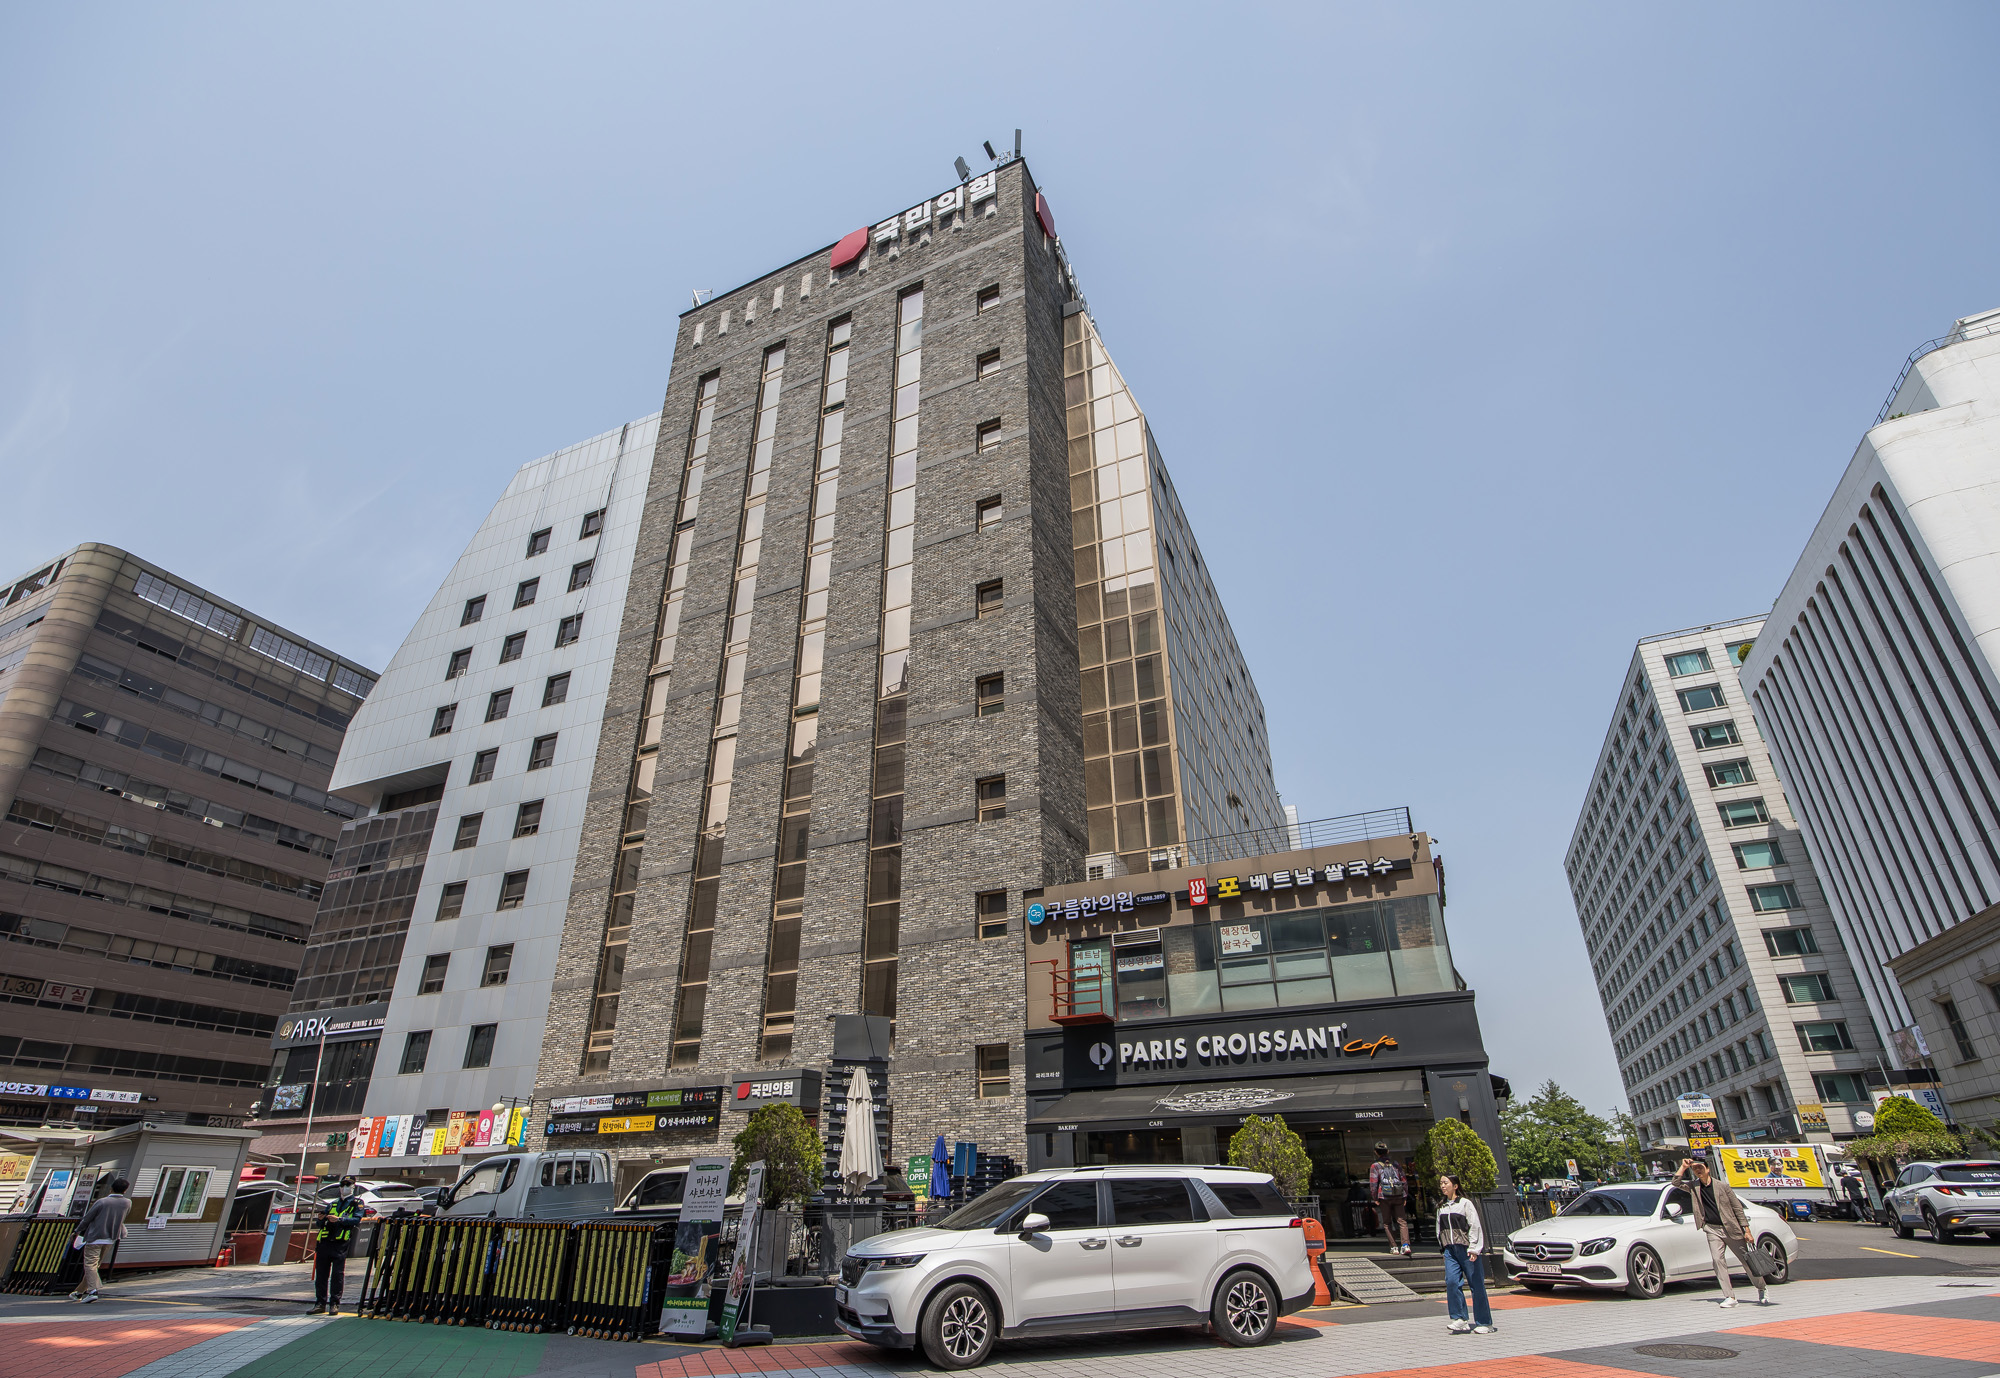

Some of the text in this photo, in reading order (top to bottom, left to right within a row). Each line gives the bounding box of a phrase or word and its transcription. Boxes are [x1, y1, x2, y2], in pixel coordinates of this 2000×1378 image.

[875, 170, 996, 243] 국민의힘
[1217, 856, 1394, 900] 포 베트남 쌀국수
[1046, 891, 1134, 921] 구름한의원
[1222, 938, 1251, 951] 쌀국수
[1075, 950, 1100, 961] 베트남
[1118, 954, 1162, 968] 정상영업중
[291, 1016, 332, 1039] ARK
[1120, 1038, 1187, 1064] PARIS
[1196, 1025, 1342, 1058] CROISSANT
[53, 1087, 87, 1097] 칼국수
[751, 1081, 793, 1098] 국민의힘
[1355, 1111, 1384, 1119] BRUNCH
[554, 1122, 581, 1133] 구름한의원
[602, 1122, 625, 1131] 원할머니
[1744, 1148, 1791, 1158] 권성동 퇴출
[1733, 1159, 1809, 1173] 윤석열 꼬봉
[696, 1175, 719, 1188] 미나리
[909, 1173, 928, 1182] OPEN
[1750, 1178, 1803, 1187] 막장경선 주범
[688, 1187, 722, 1199] 샤브샤브
